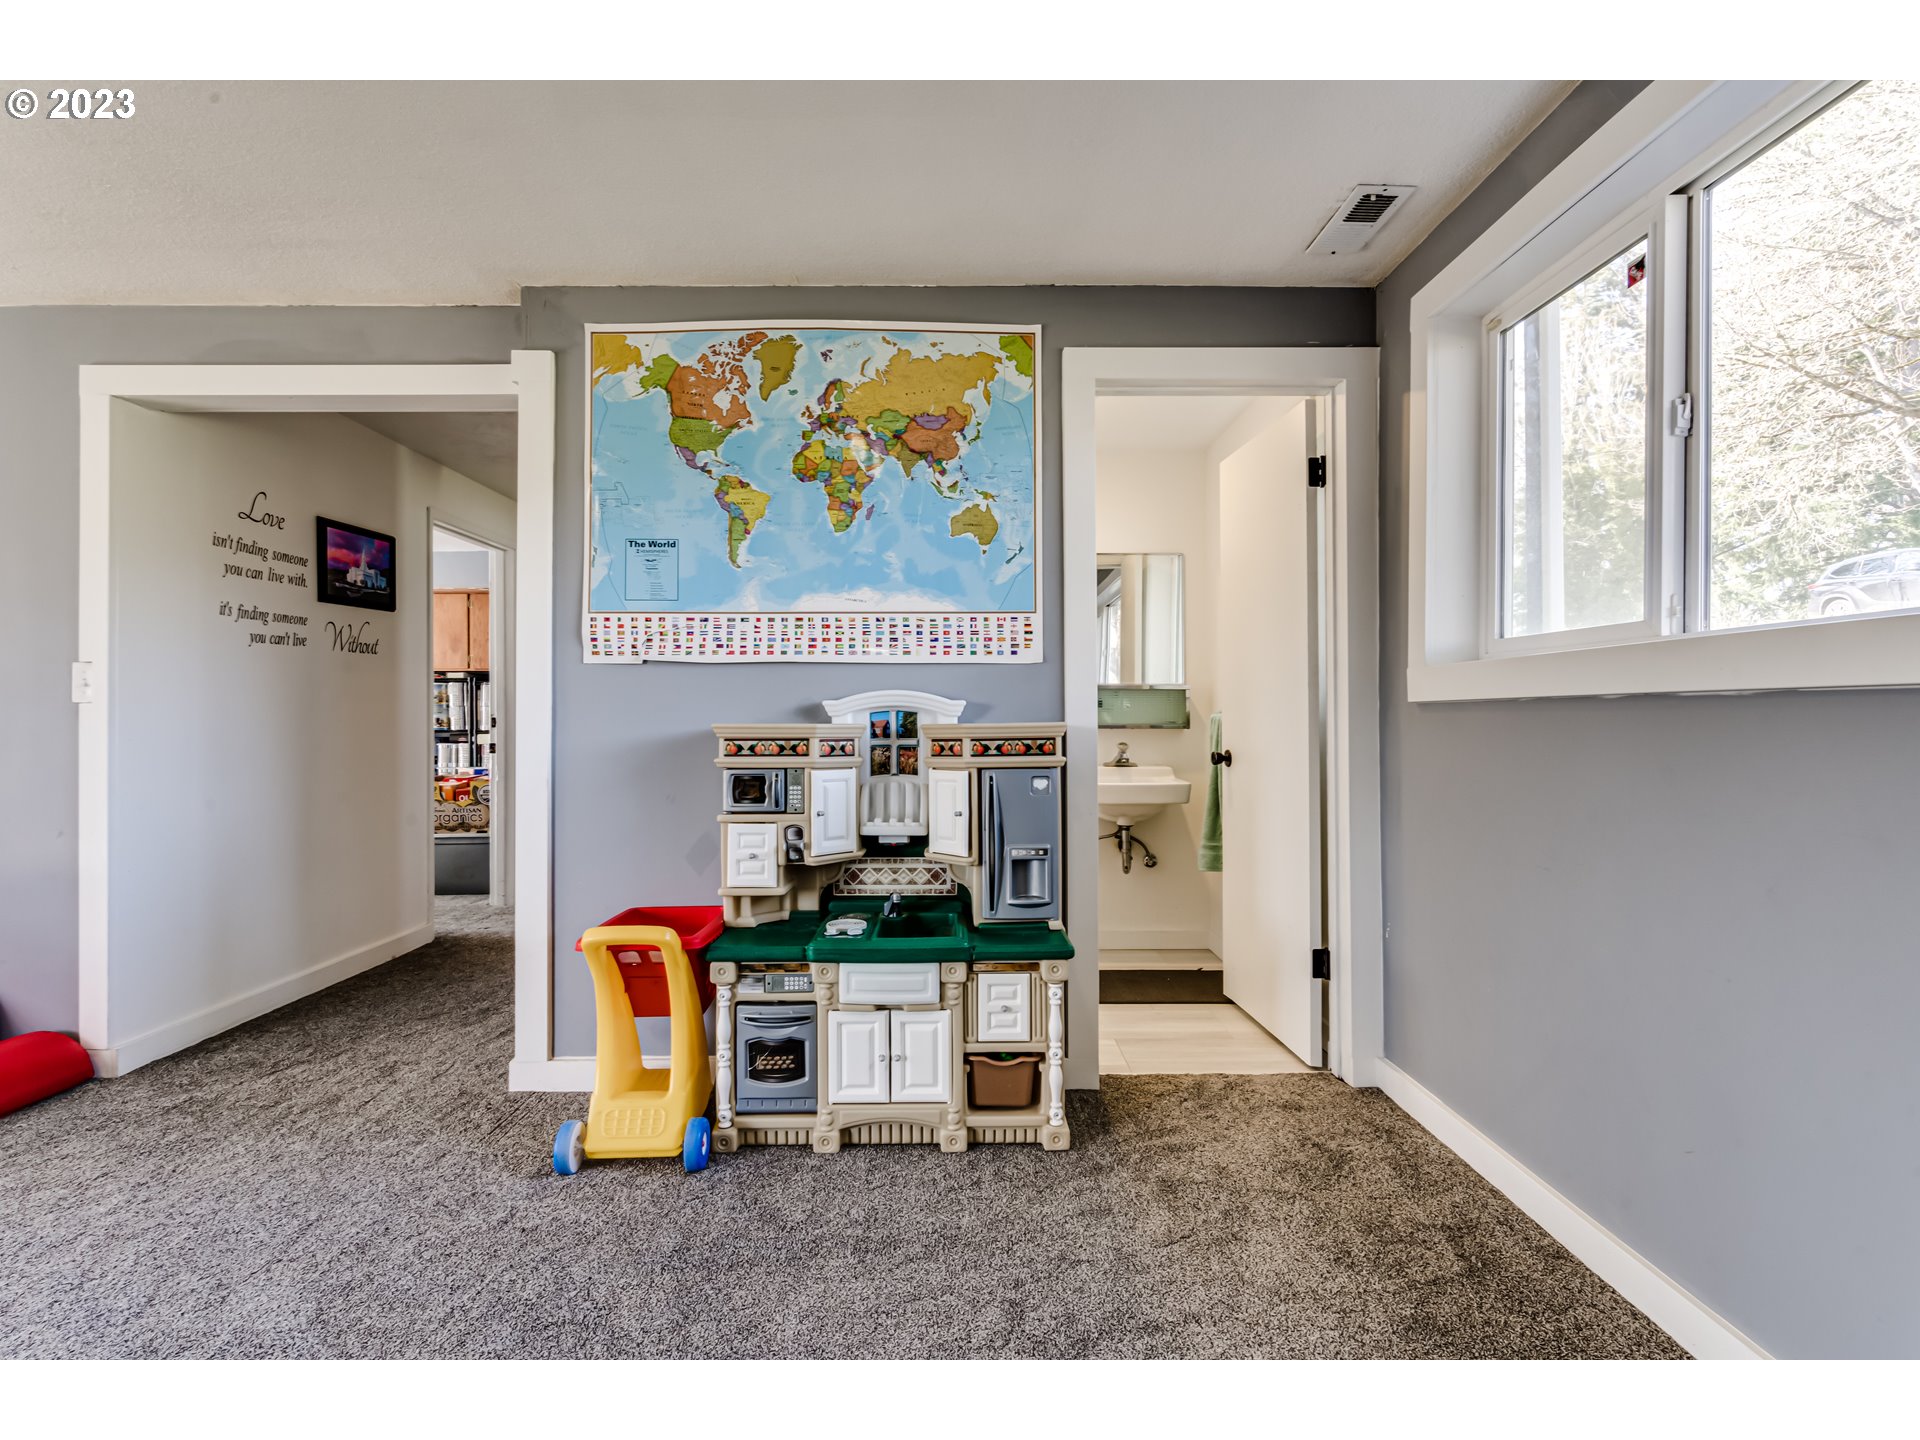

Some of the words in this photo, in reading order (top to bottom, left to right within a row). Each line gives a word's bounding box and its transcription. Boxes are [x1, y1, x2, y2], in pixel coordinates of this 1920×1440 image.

[238, 491, 286, 530] Love
[212, 531, 234, 550] isn't
[233, 536, 269, 563] finding
[272, 548, 309, 568] someone
[627, 540, 647, 549] The
[648, 540, 677, 549] World
[222, 562, 243, 578] you
[245, 566, 264, 581] can
[267, 566, 285, 584] live
[287, 571, 309, 589] with.
[219, 600, 233, 617] it's
[234, 604, 270, 626] finding
[272, 612, 309, 627] someone
[248, 631, 266, 647] you
[269, 631, 290, 647] can't
[292, 631, 308, 647] live
[324, 621, 380, 656] Without
